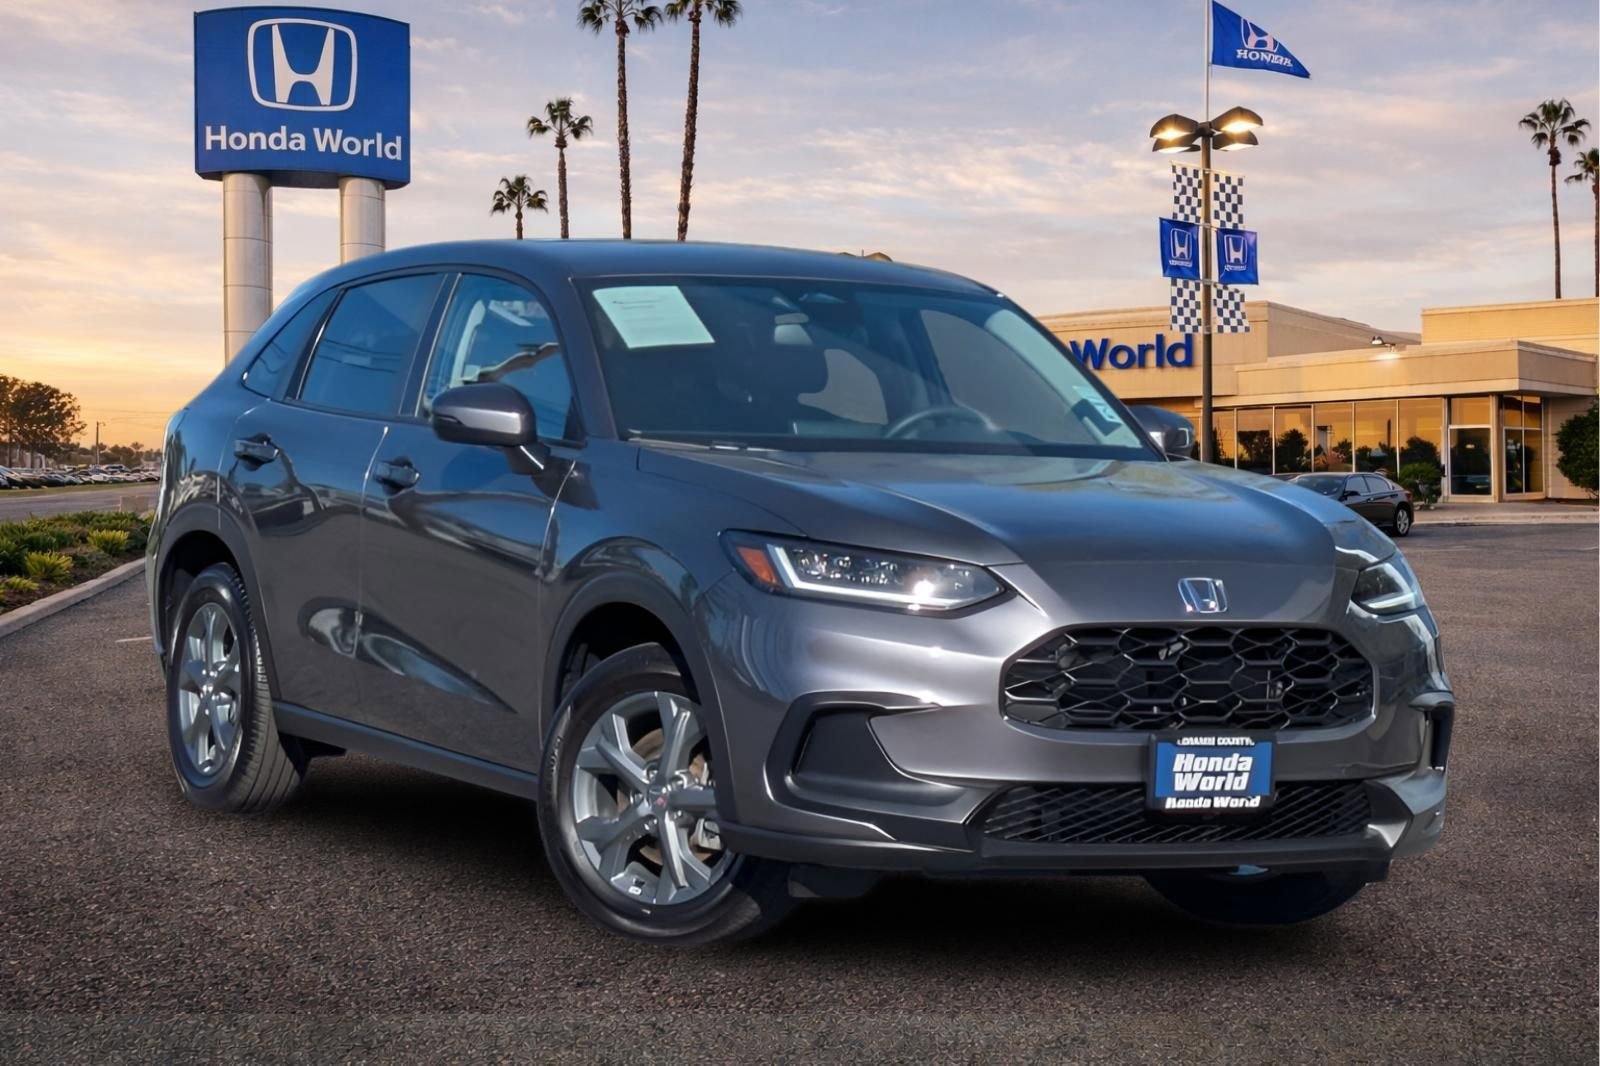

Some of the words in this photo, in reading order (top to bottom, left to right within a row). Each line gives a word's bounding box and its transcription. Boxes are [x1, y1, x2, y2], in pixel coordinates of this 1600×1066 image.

[205, 125, 306, 151] Honda
[313, 127, 402, 161] World
[1069, 333, 1194, 370] World
[1172, 753, 1253, 772] Honda
[1174, 772, 1250, 791] World
